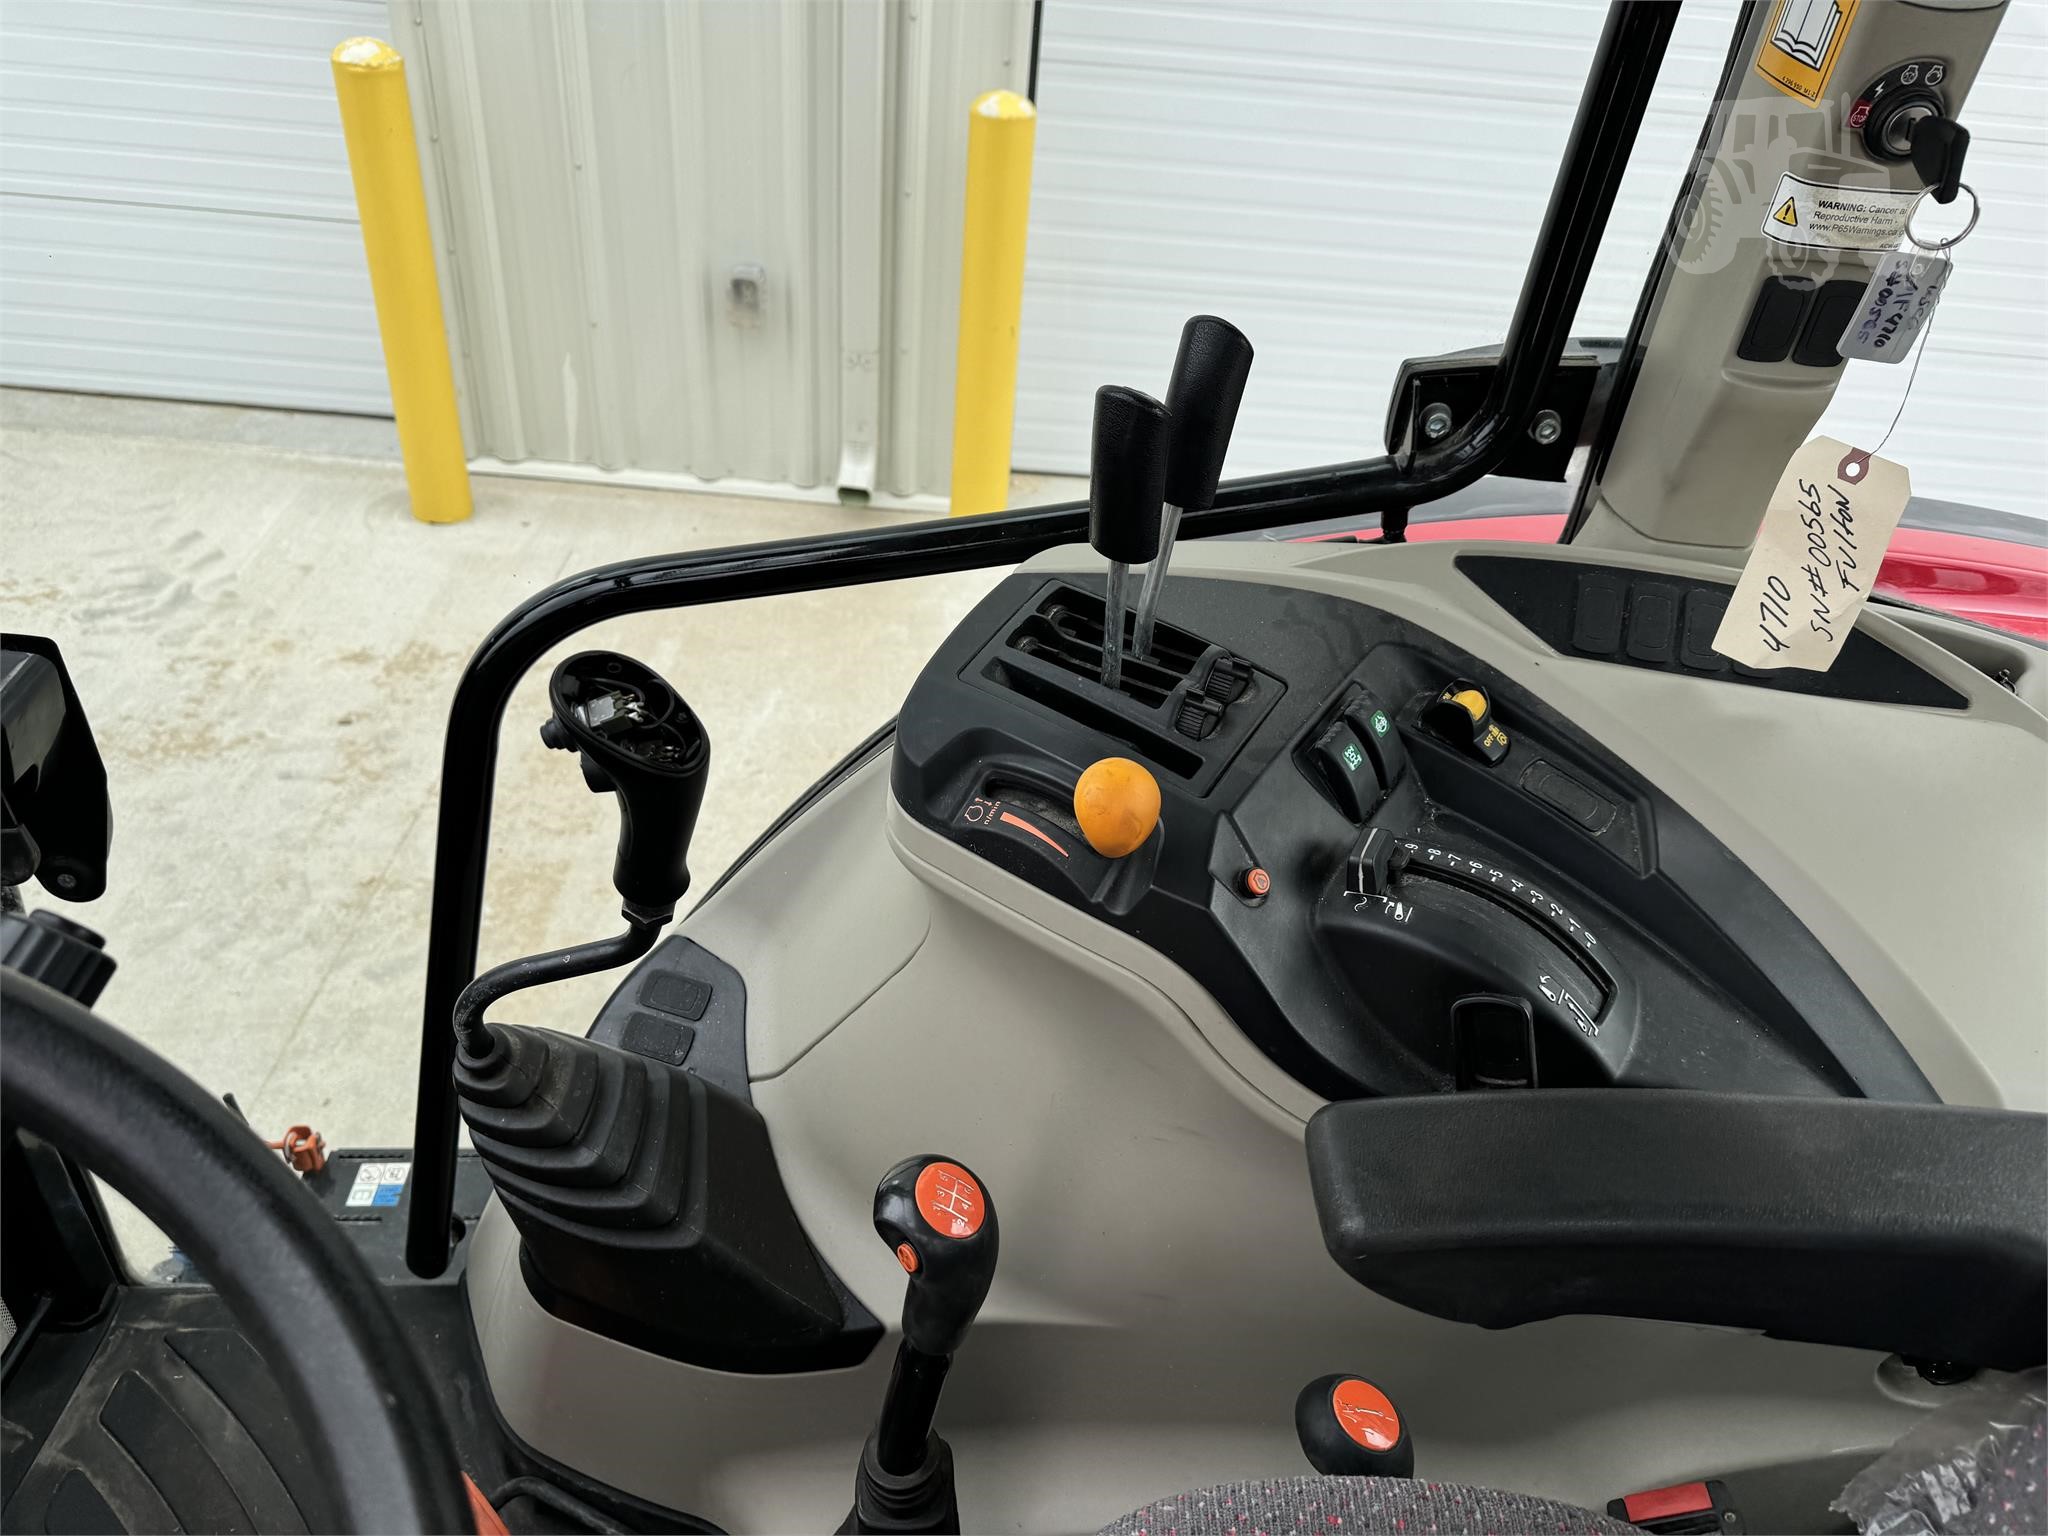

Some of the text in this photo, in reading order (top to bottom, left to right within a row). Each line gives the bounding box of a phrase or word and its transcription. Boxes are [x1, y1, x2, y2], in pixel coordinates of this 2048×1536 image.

[1818, 200, 1866, 213] WARNING:
[1868, 204, 1898, 215] Cancer
[1813, 211, 1868, 225] Reproductive
[1870, 216, 1894, 225] Harm
[1759, 575, 1791, 652] 4710
[1483, 733, 1495, 747] OFF
[984, 801, 1001, 825] n/min
[1427, 848, 1442, 856] 8
[1469, 861, 1483, 869] 6
[1489, 869, 1503, 878] 5
[1511, 879, 1524, 888] 4
[1530, 890, 1543, 900] 3
[1550, 903, 1563, 915] 2
[1569, 918, 1581, 929] 1
[1584, 931, 1597, 944] 0
[962, 1202, 970, 1210] 4
[957, 1218, 966, 1226] 2
